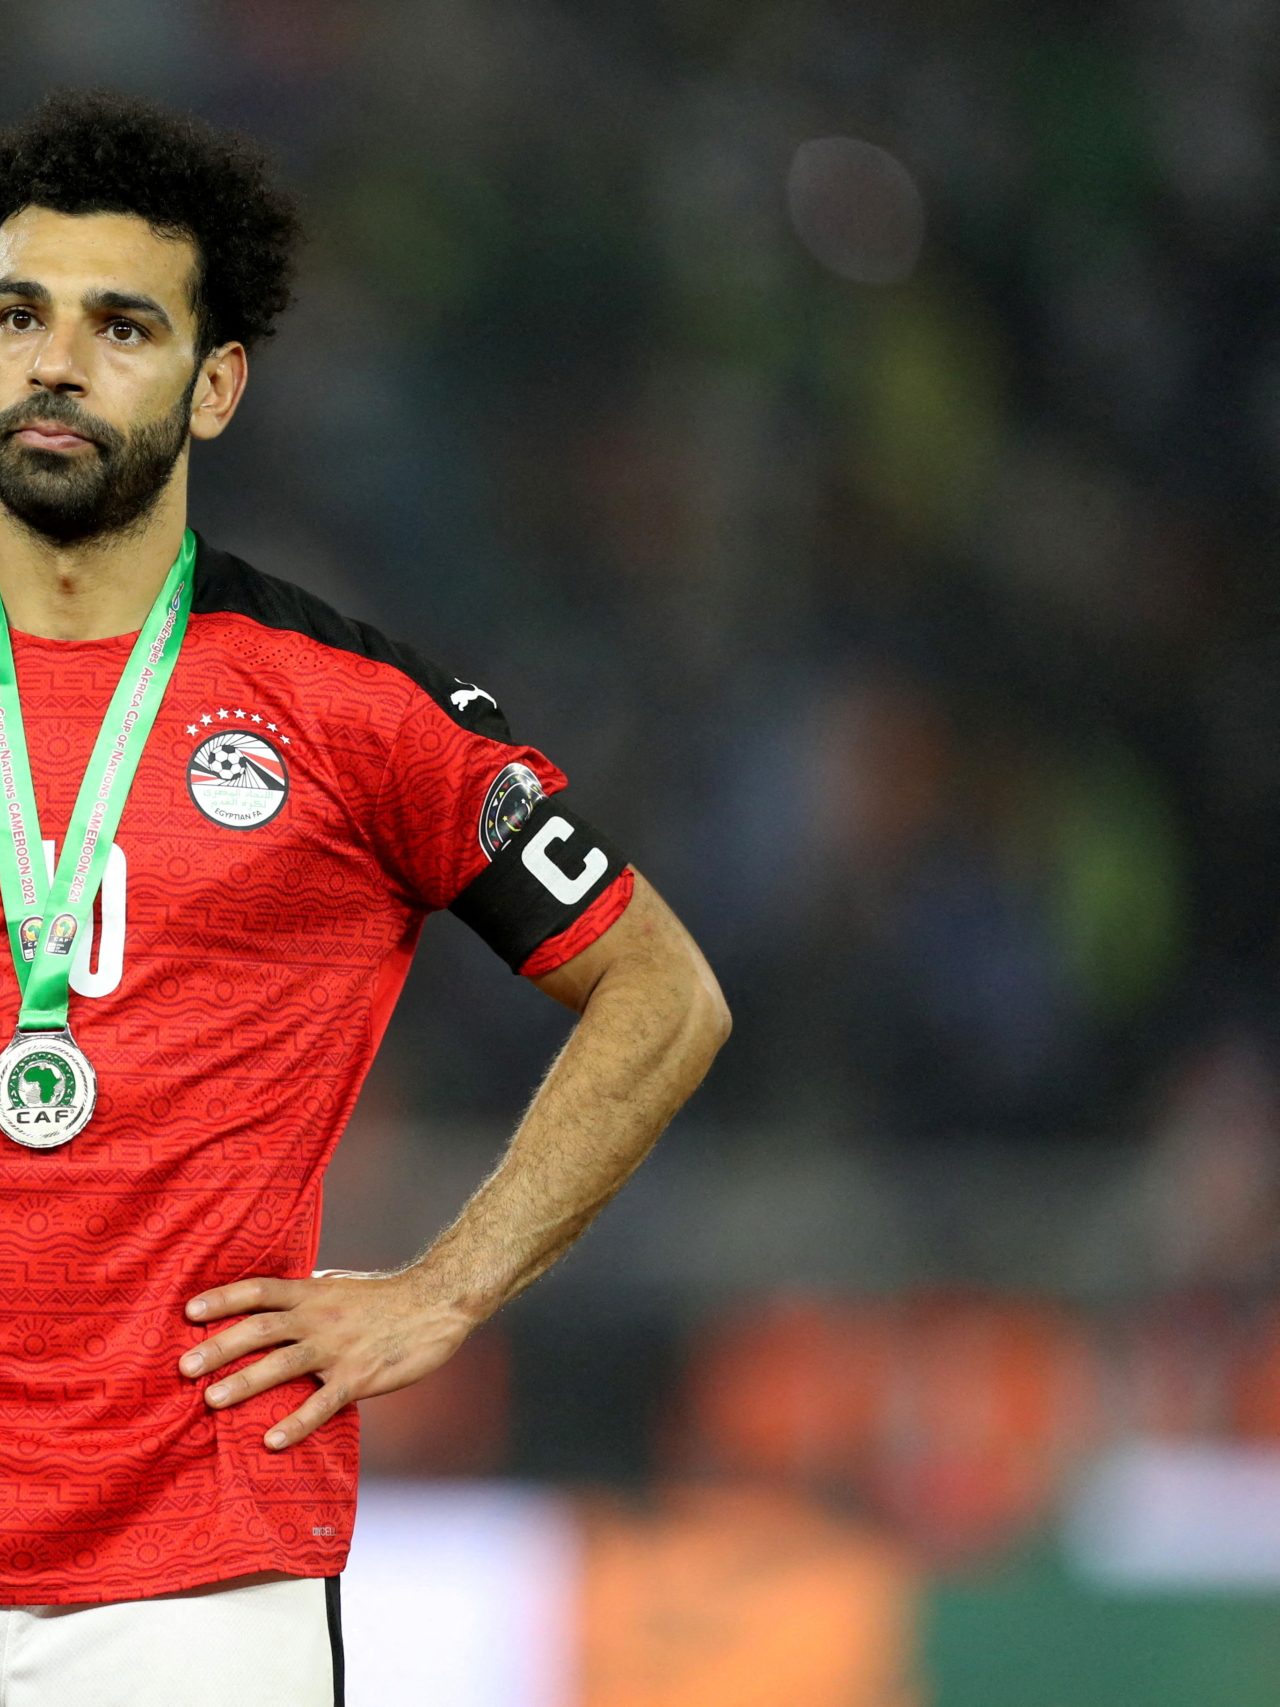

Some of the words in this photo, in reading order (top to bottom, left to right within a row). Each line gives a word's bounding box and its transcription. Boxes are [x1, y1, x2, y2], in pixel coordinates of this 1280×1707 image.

[150, 609, 176, 663] otalEnergies
[78, 803, 106, 873] CAMEROON
[214, 808, 251, 820] EGYPTIAN
[252, 810, 262, 818] FA
[8, 803, 31, 875] CAMEROON
[21, 878, 36, 905] 2021
[521, 816, 609, 905] C
[70, 876, 84, 902] 2021
[16, 1110, 68, 1124] CAF
